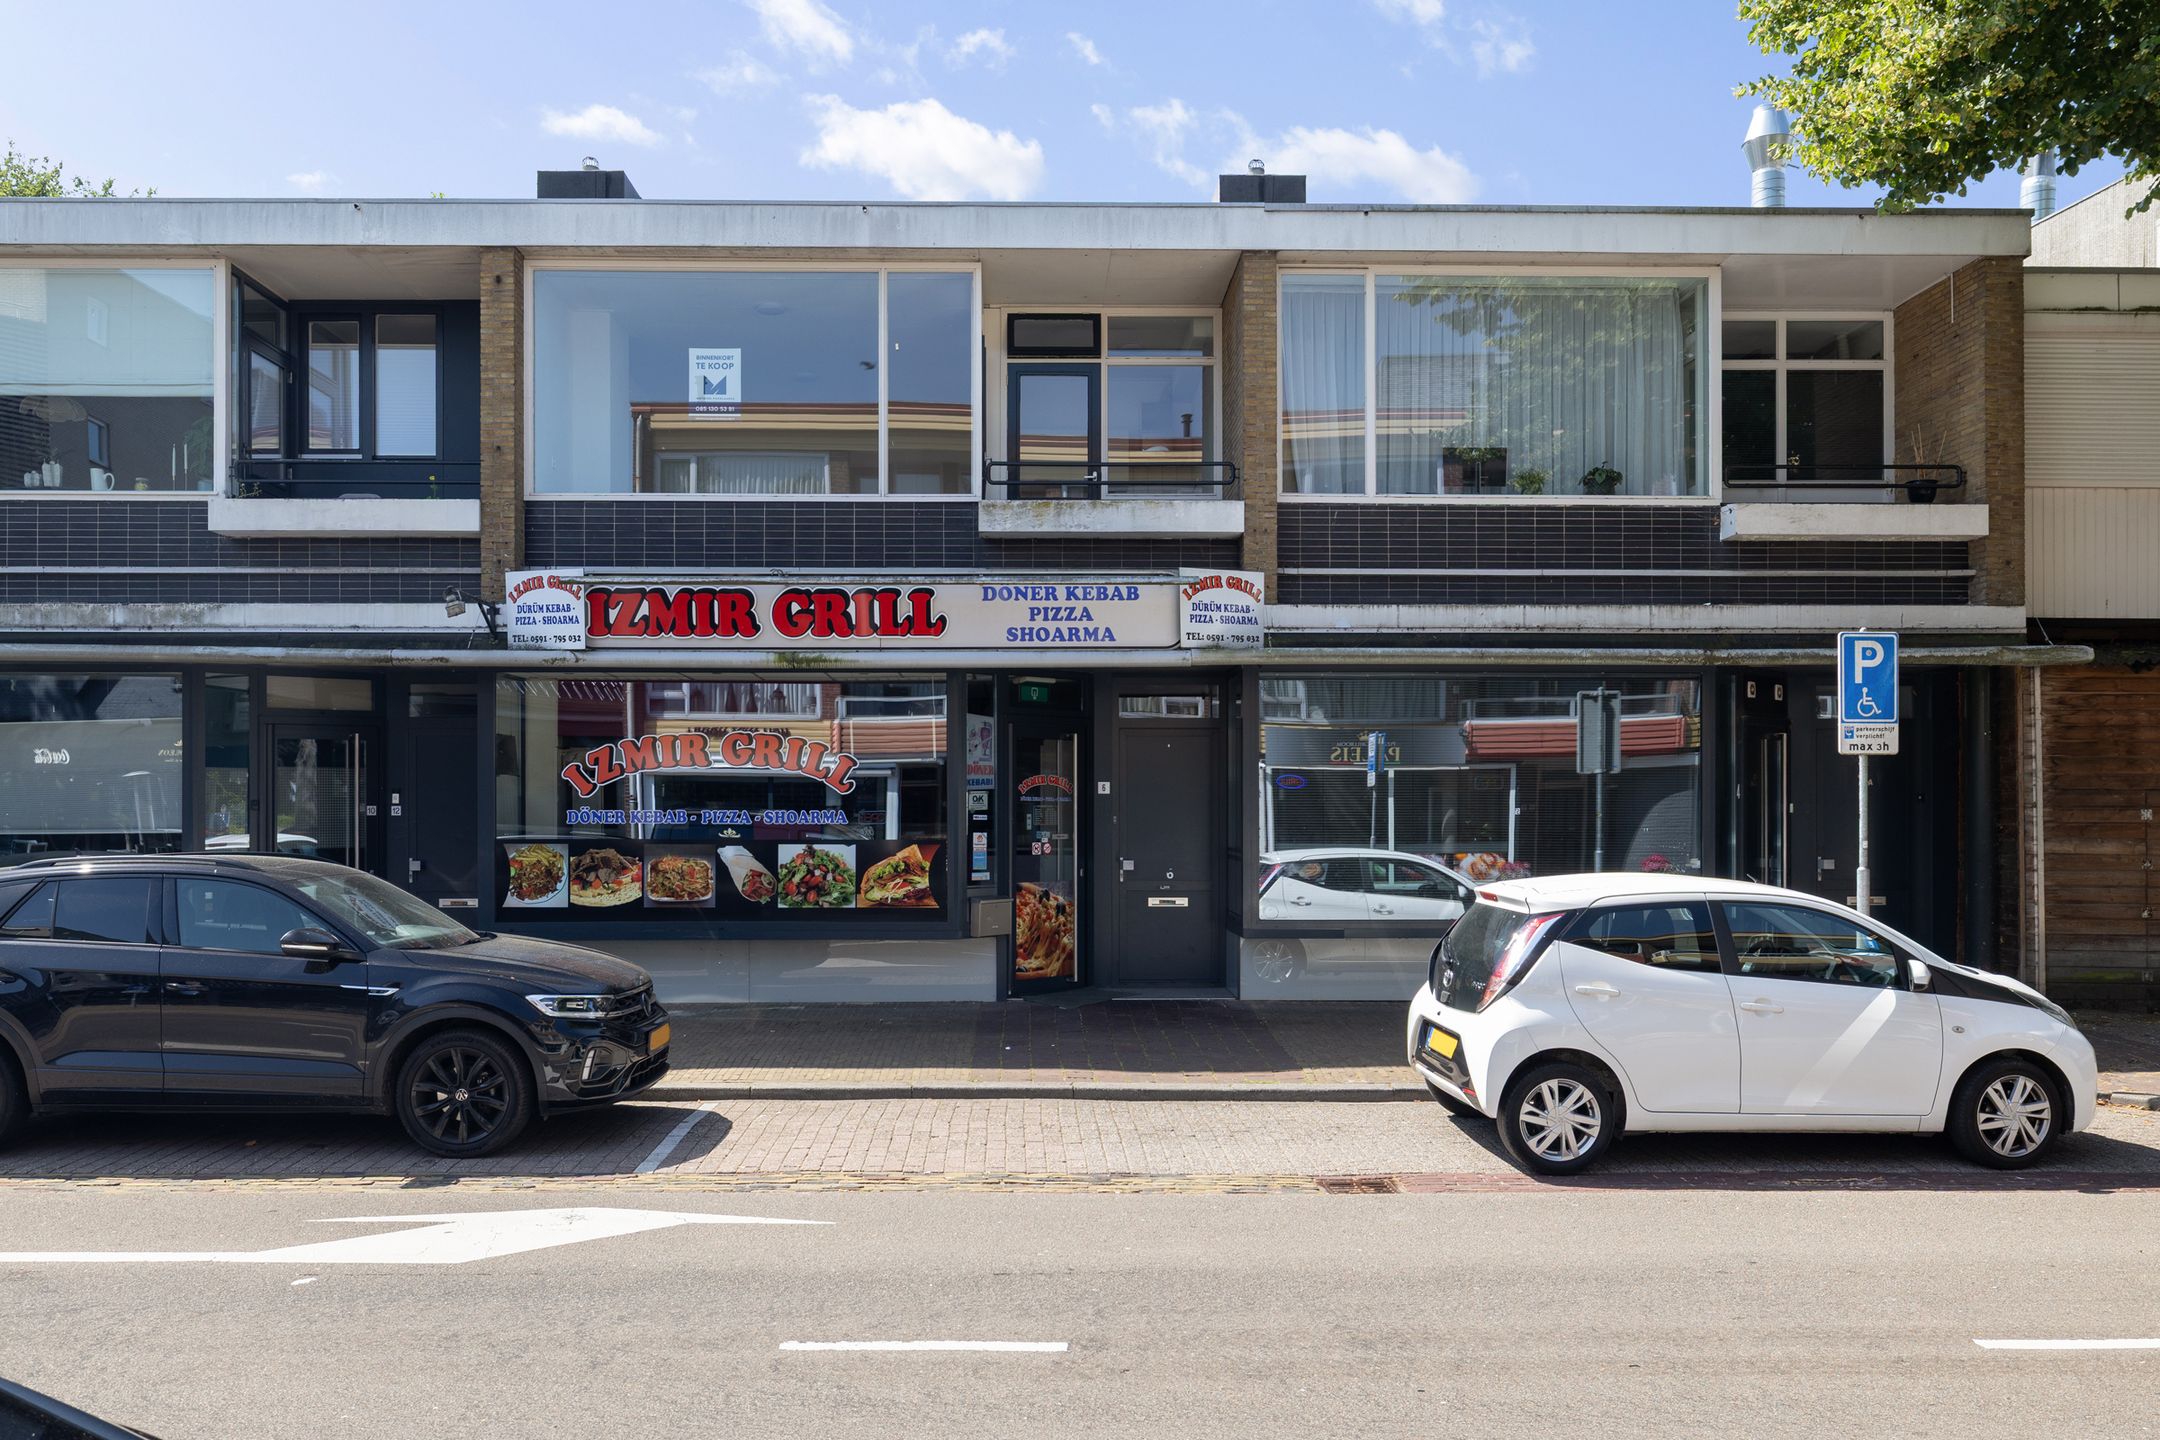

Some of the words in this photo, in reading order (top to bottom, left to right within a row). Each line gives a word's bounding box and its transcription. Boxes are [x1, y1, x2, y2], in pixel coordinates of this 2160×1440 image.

[508, 575, 545, 604] IZMIR
[982, 586, 1060, 602] DONER
[1065, 586, 1140, 602] KEBAB
[1182, 575, 1223, 601] IZMIR
[1226, 576, 1262, 603] GRILL
[517, 602, 544, 614] DÜRÜM
[546, 603, 571, 613] KEBAB
[586, 586, 762, 640] IZMIR
[772, 586, 948, 640] GRILL
[1028, 606, 1094, 622] PIZZA
[1192, 600, 1222, 612] DÜRÜM
[1224, 604, 1251, 614] KEBAB
[515, 616, 537, 625] PIZZA
[543, 615, 580, 625] SHOARMA
[1190, 614, 1213, 624] PIZZA
[1220, 615, 1259, 625] SHOARMA
[512, 635, 528, 643] TEL:
[530, 635, 547, 643] 0591
[553, 635, 566, 643] 795
[568, 635, 581, 643] 032
[1006, 627, 1116, 642] SHOARMA
[1186, 632, 1204, 641] TEL:
[1207, 634, 1224, 642] 0591
[1231, 634, 1244, 643] 795
[1246, 635, 1260, 643] 032
[1854, 640, 1885, 684] P
[1849, 743, 1873, 751] max
[1876, 741, 1889, 751] 3h
[562, 733, 712, 797] IZMIR
[721, 732, 859, 795] GRILL
[392, 806, 400, 815] 12
[566, 806, 626, 825] DÖNER
[629, 809, 688, 825] KEBAB
[701, 809, 752, 825] PIZZA
[764, 809, 849, 825] SHOARMA
